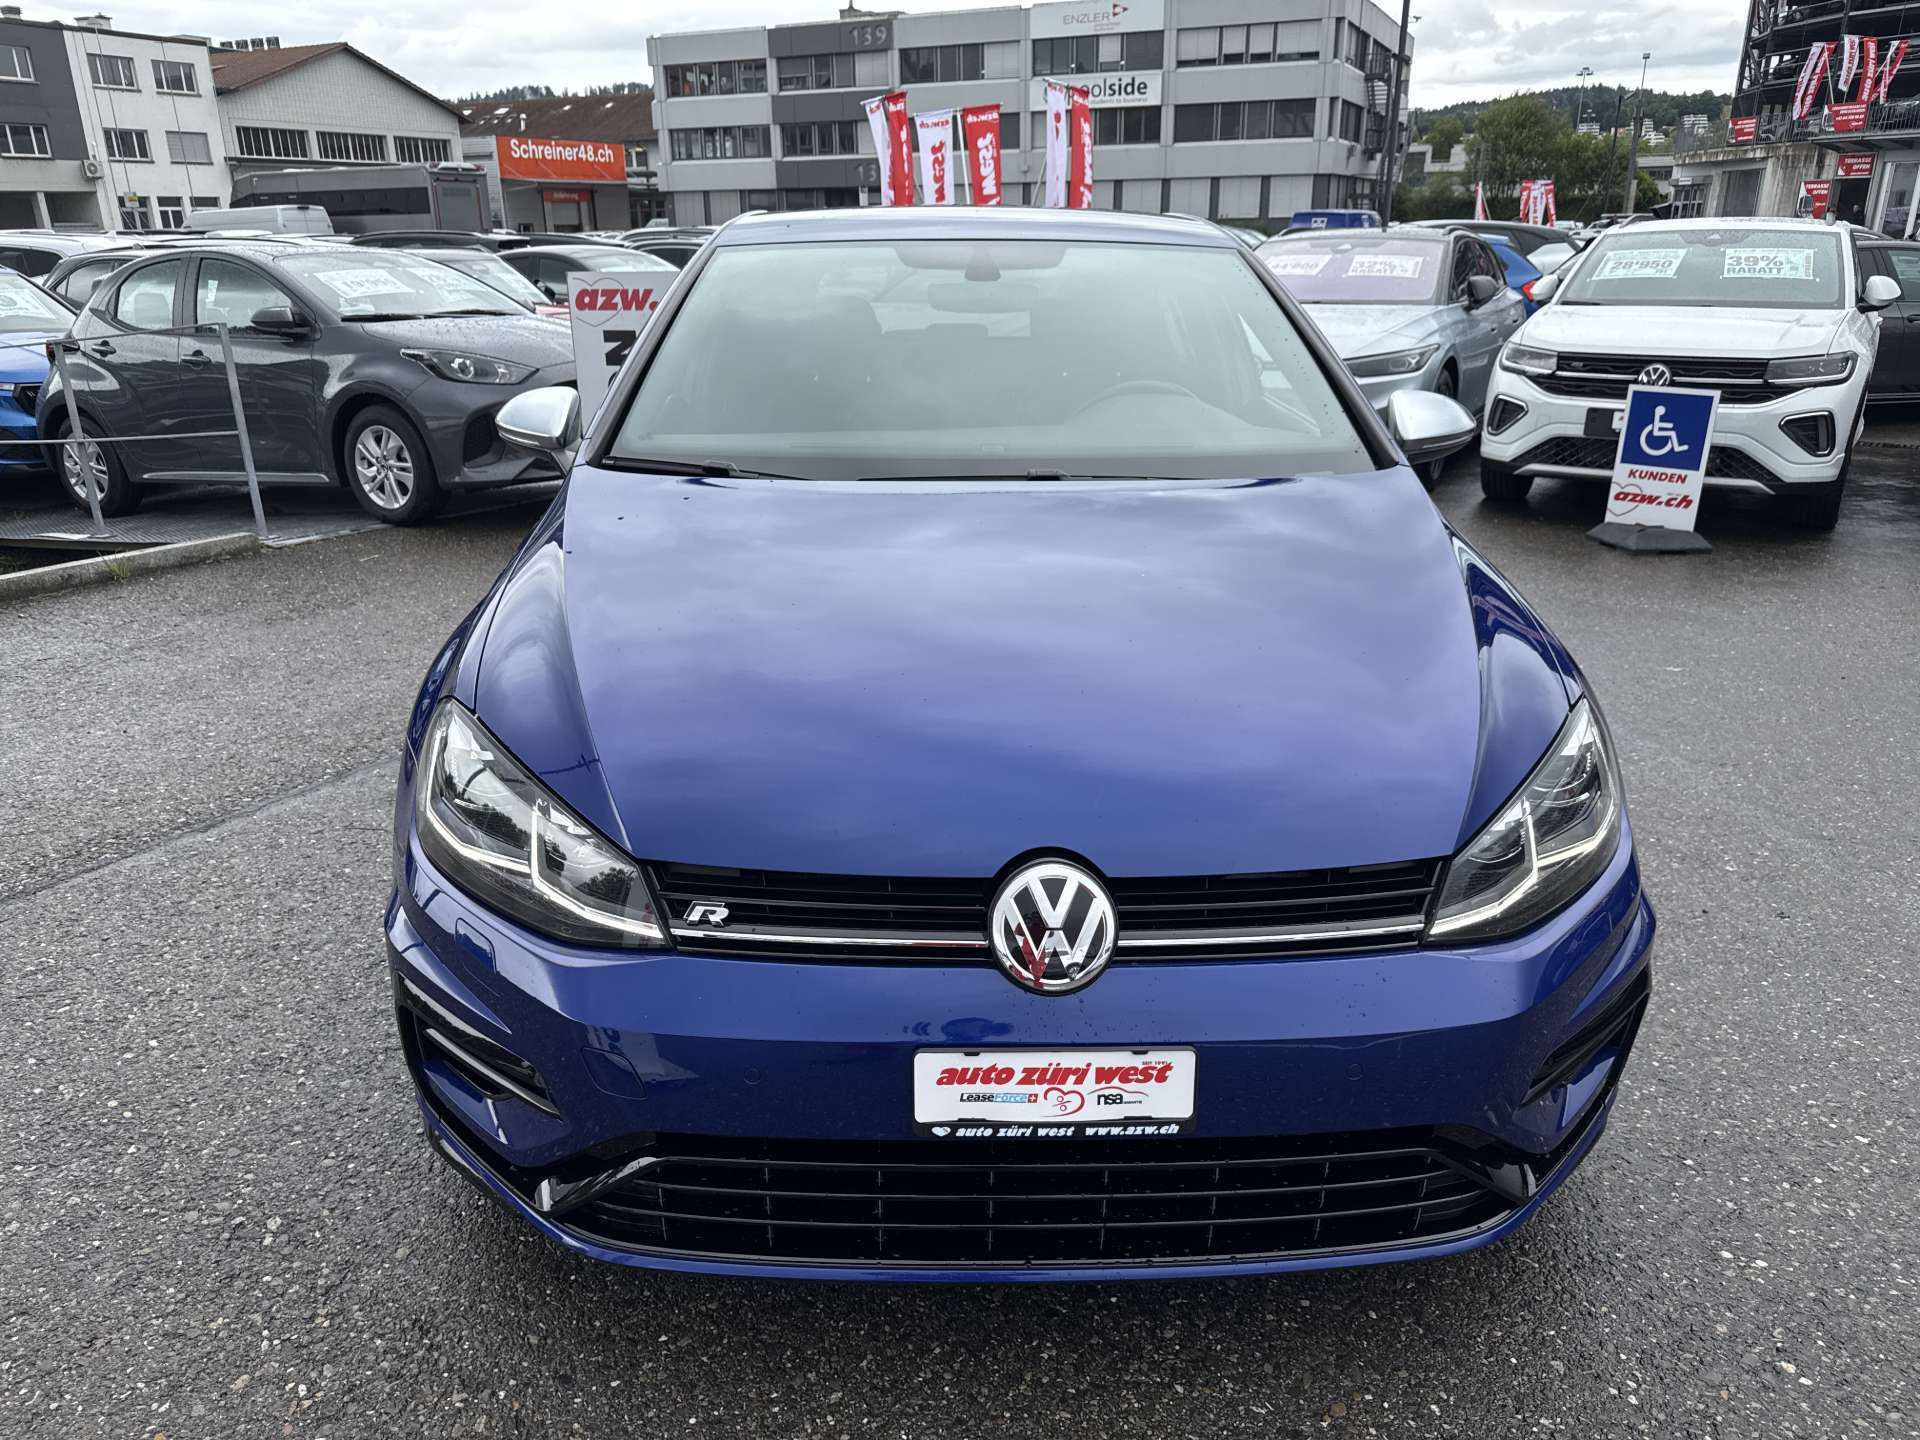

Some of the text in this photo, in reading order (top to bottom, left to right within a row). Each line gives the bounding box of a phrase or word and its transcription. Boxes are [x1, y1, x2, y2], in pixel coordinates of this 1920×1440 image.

[1063, 12, 1111, 25] ENZLER
[850, 25, 888, 46] 139
[510, 138, 614, 163] Schreiner48.ch
[1612, 260, 1673, 269] 28'950
[1727, 255, 1784, 267] 39%
[1628, 469, 1687, 484] KUNDEN
[1614, 491, 1693, 509] azw.ch
[936, 1062, 1174, 1086] auto züri west
[960, 1092, 1028, 1103] LeaseForce
[1097, 1093, 1123, 1106] nsa
[956, 1124, 1180, 1137] auto züri west www.azw.ch
